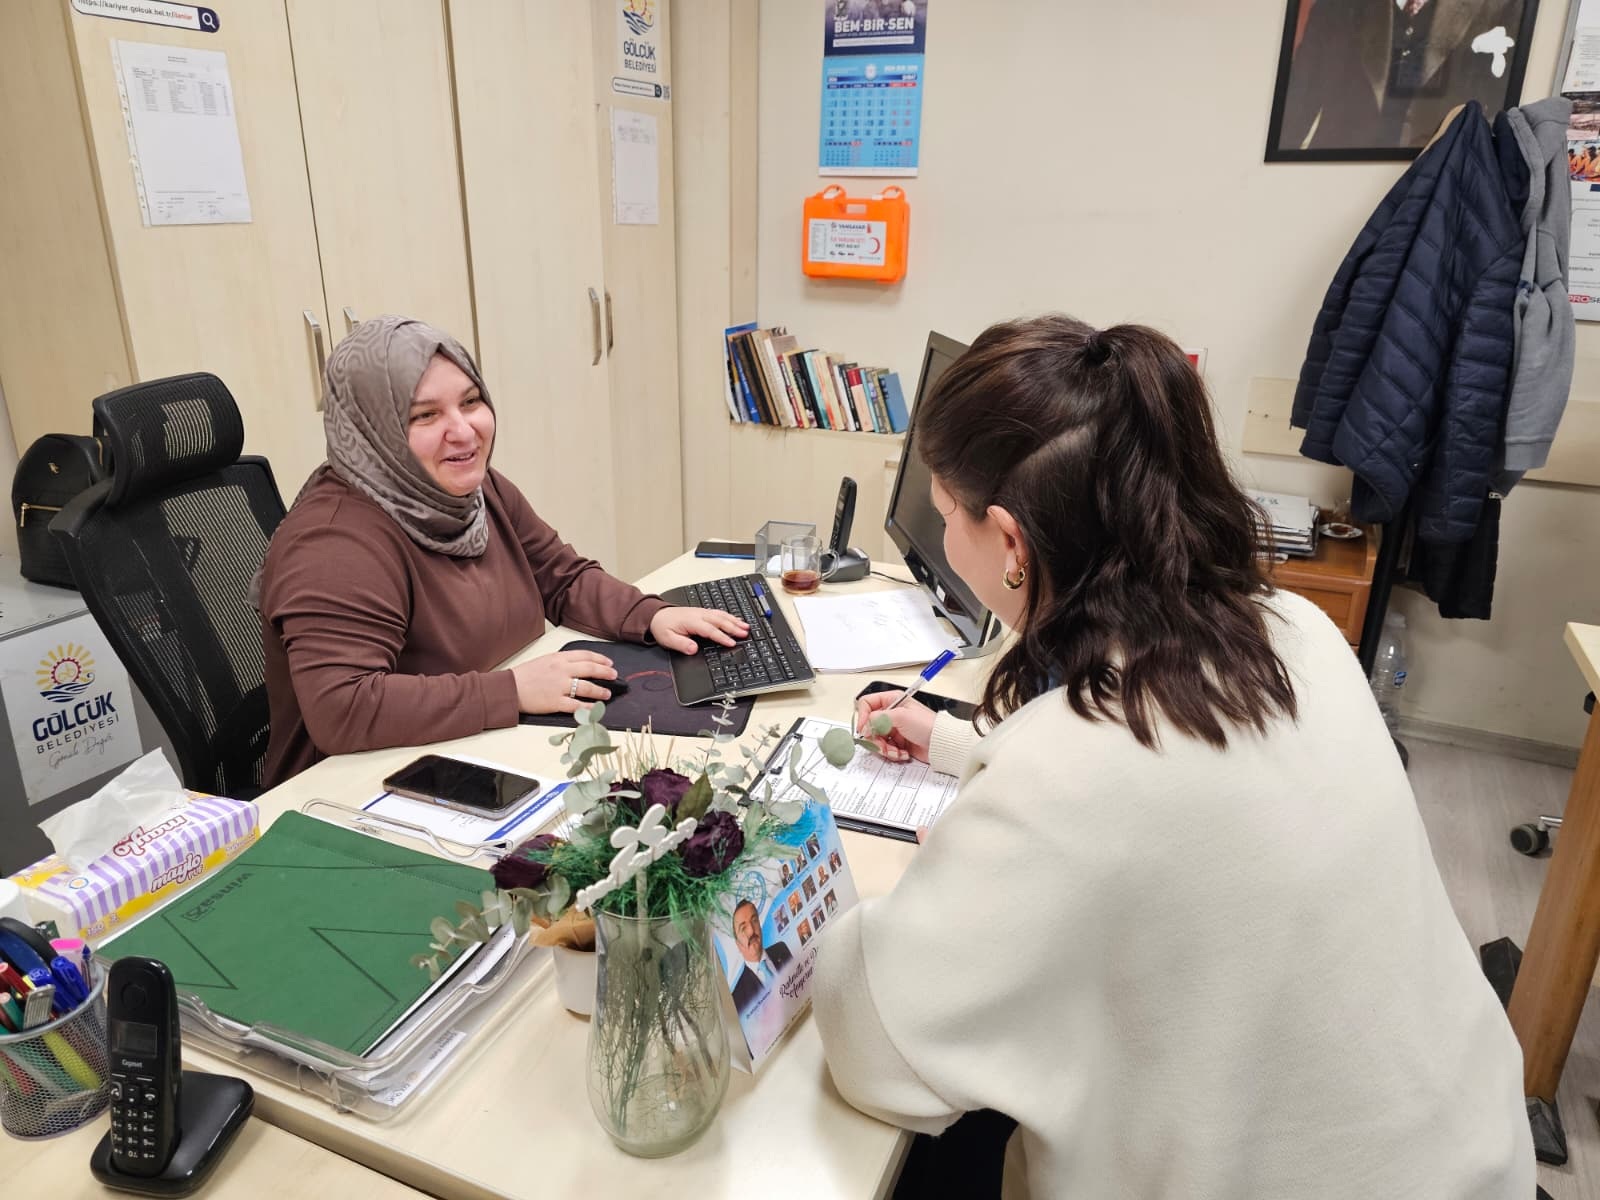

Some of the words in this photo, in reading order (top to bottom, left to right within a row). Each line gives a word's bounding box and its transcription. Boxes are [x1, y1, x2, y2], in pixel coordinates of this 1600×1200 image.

[624, 38, 656, 60] GÖLCÜK
[32, 691, 117, 741] GÖLCÜK
[36, 713, 120, 754] BELEDİYESİ
[151, 852, 202, 893] maylo
